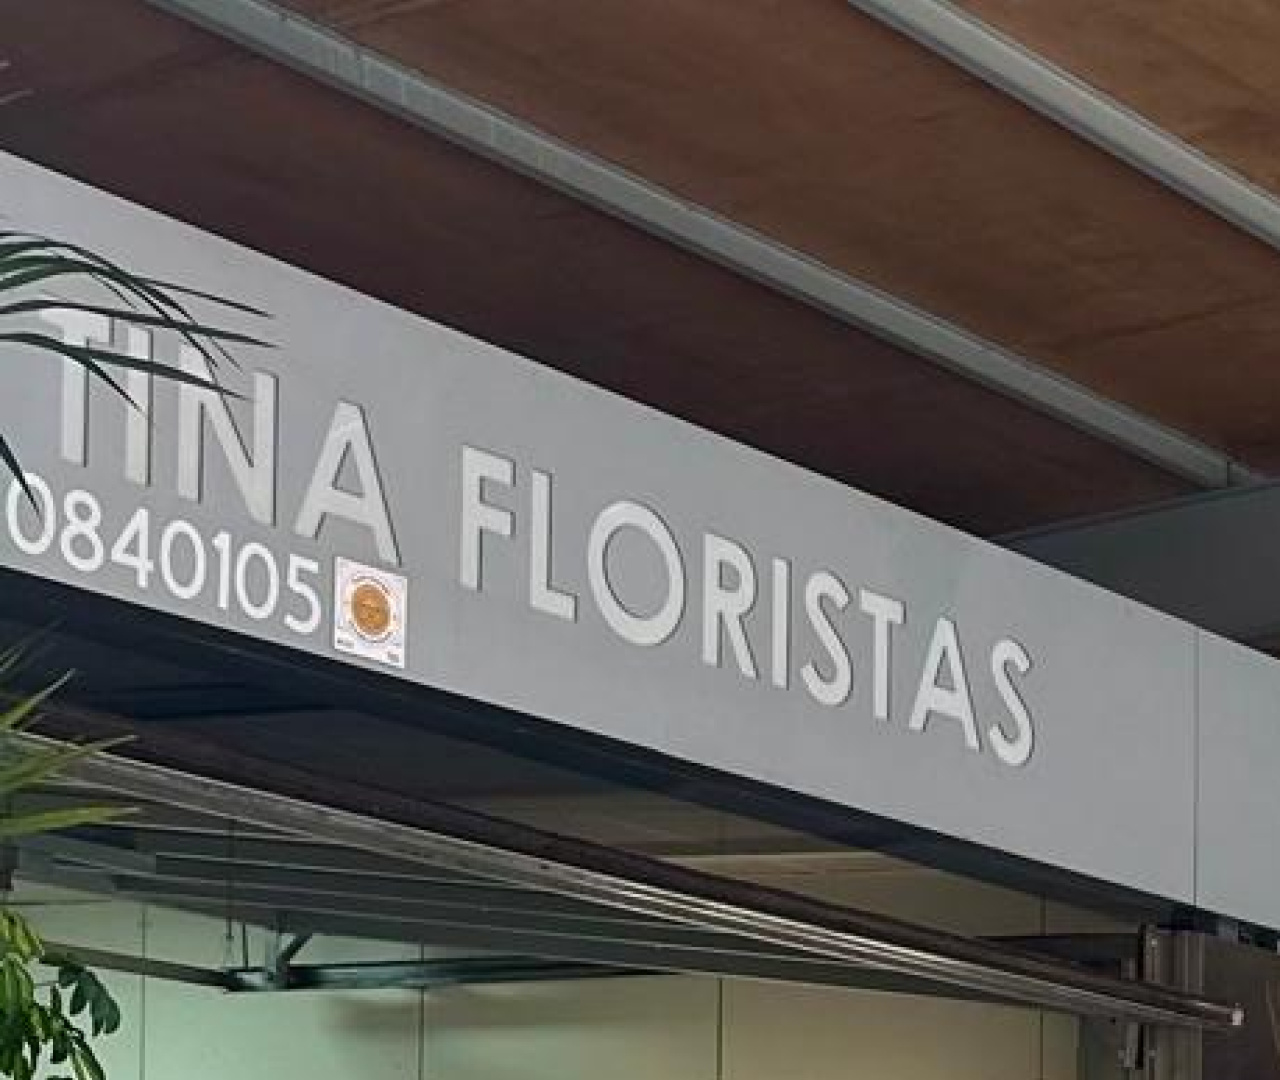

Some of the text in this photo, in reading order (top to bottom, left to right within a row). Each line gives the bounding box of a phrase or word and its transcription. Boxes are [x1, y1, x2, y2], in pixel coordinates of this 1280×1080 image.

[7, 472, 322, 633] 0840105
[39, 305, 1034, 766] TINA FLORISTAS
